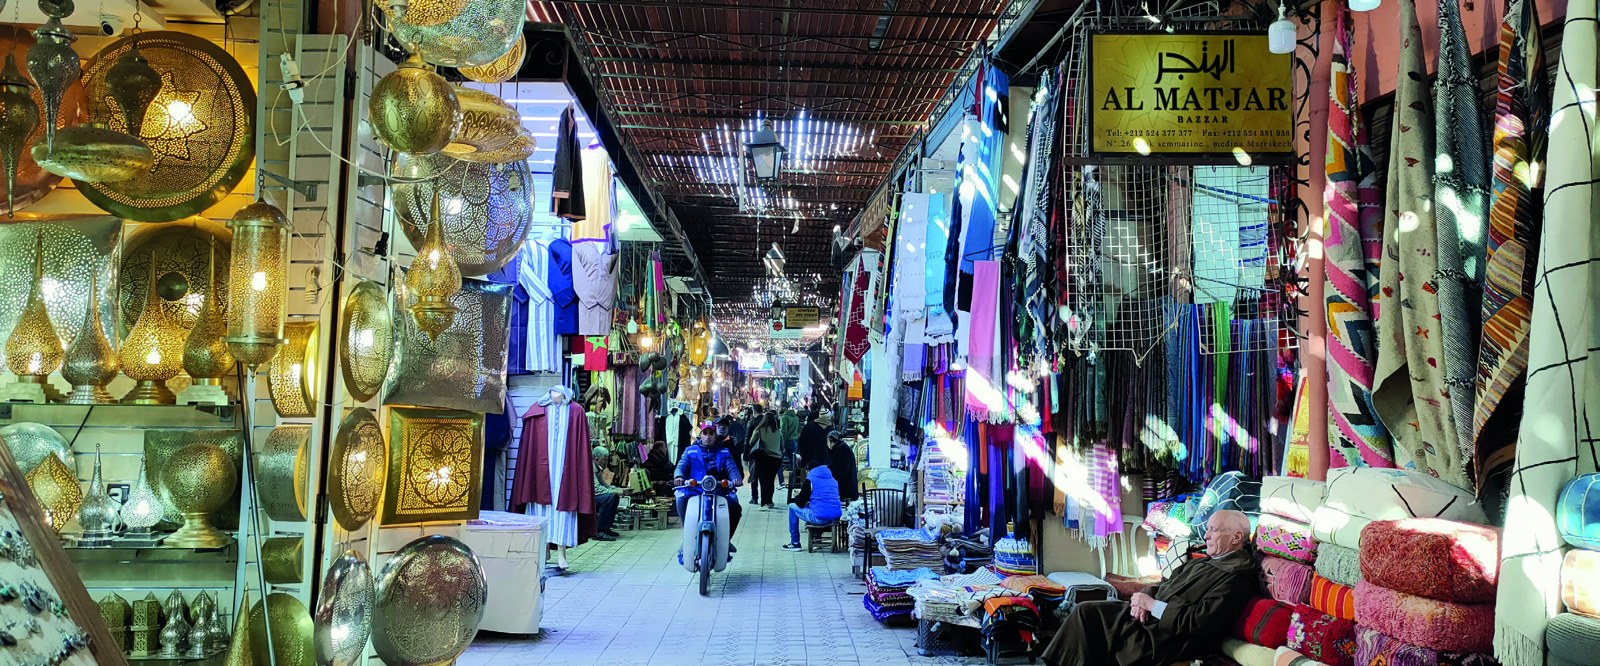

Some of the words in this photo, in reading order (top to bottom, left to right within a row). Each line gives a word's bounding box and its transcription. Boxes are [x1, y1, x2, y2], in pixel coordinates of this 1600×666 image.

[1101, 87, 1144, 111] AL
[1154, 87, 1288, 111] MATJAR
[1177, 116, 1229, 124] BAZZAR
[1107, 129, 1122, 137] Tel:
[1124, 129, 1143, 137] +212
[1162, 129, 1176, 137] 377
[1179, 129, 1193, 137] 377
[1202, 129, 1220, 137] Fax:
[1222, 129, 1241, 137] +212
[1213, 139, 1244, 147] medina
